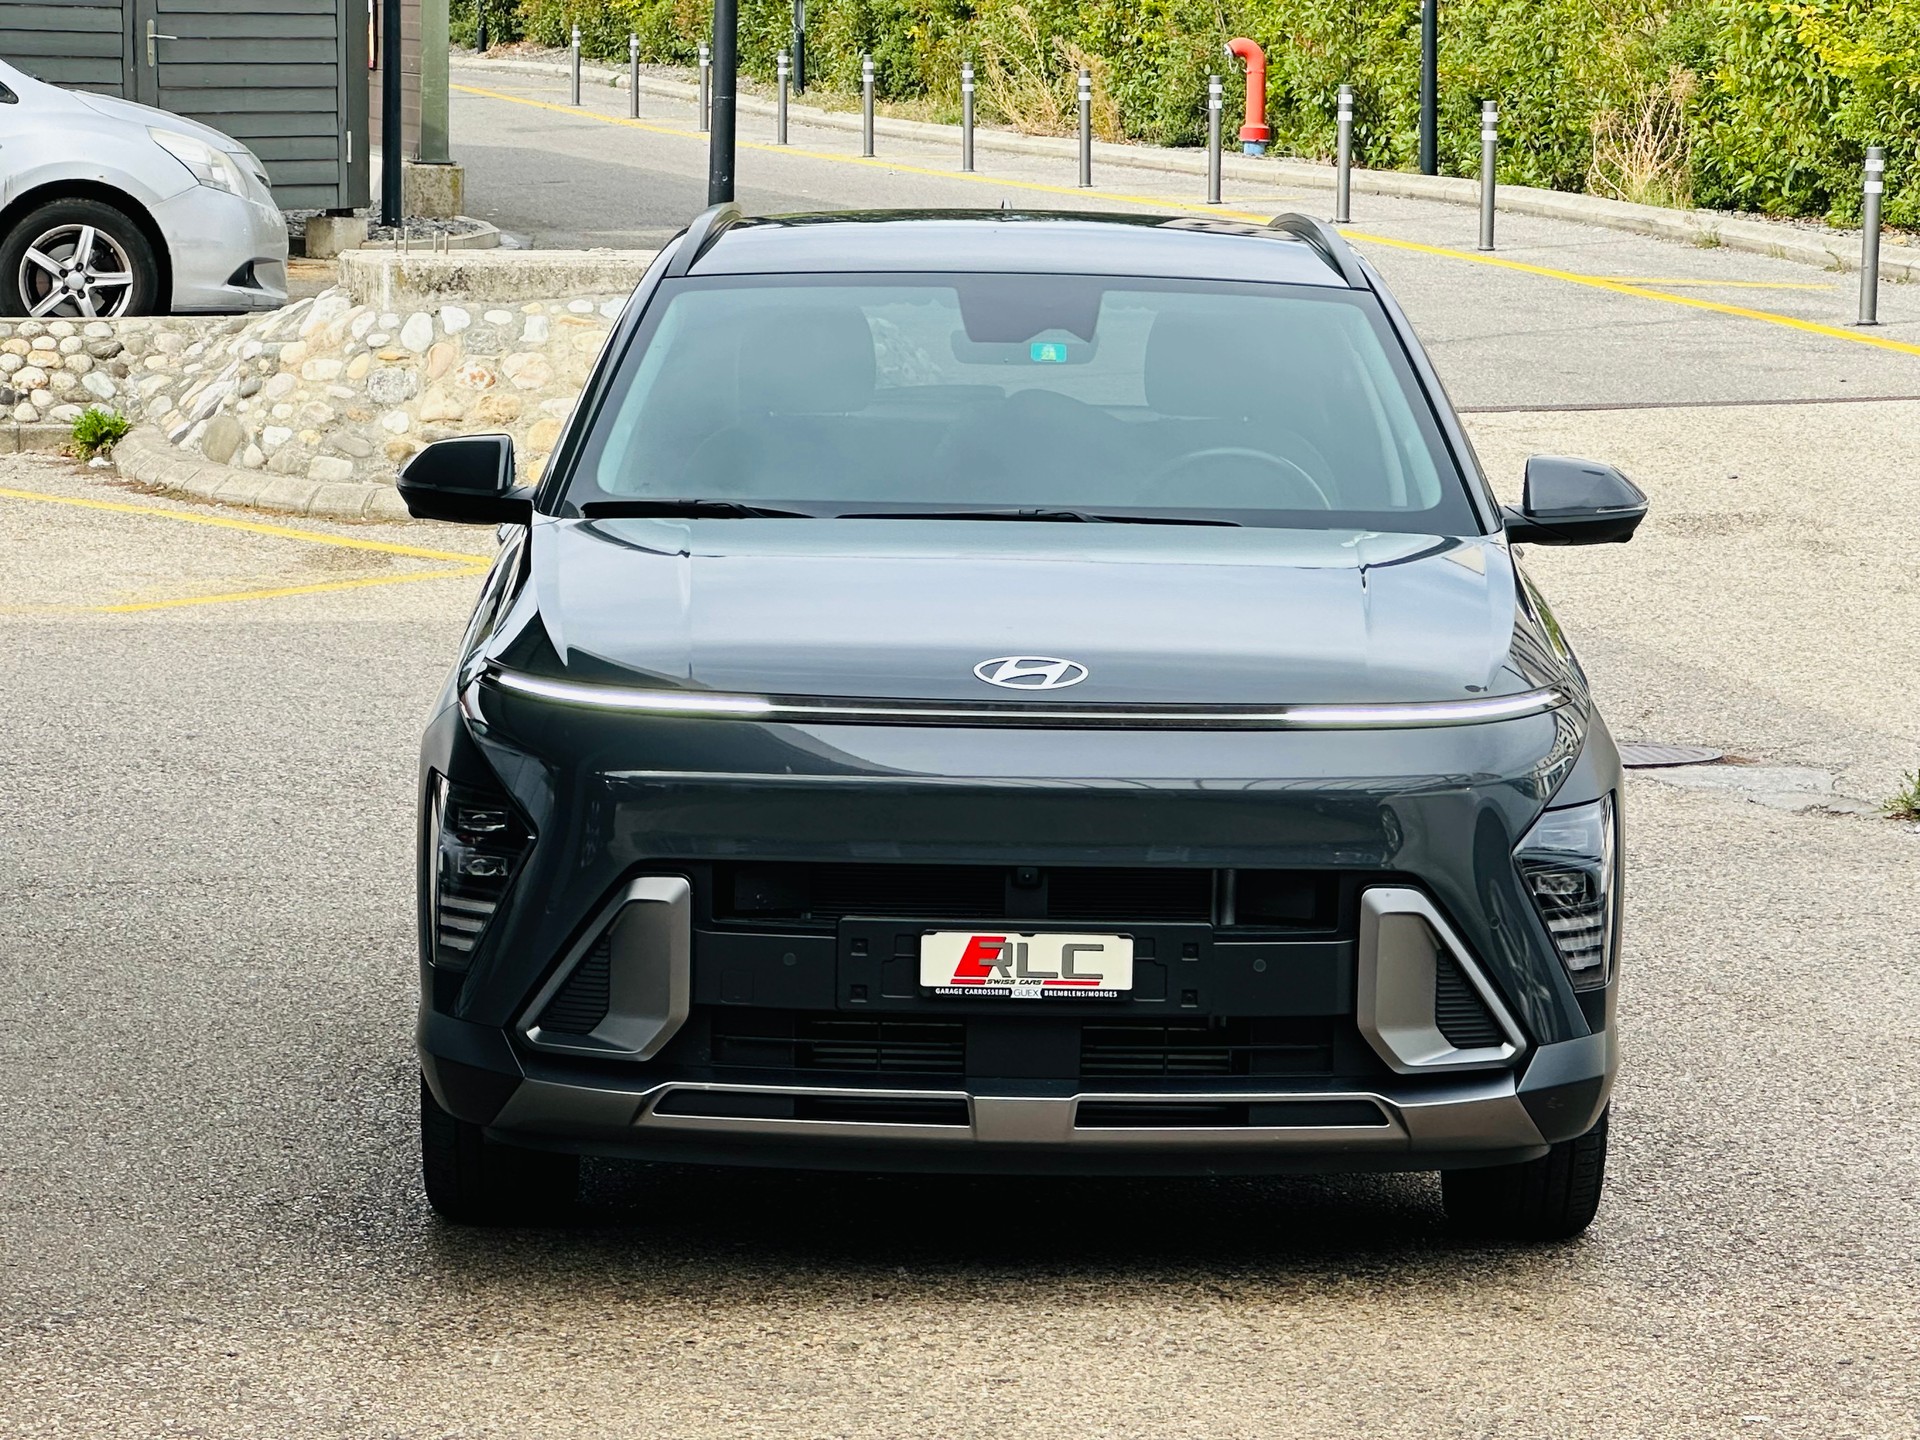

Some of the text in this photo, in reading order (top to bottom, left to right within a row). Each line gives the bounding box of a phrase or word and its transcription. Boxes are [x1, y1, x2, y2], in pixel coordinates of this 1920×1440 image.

[964, 988, 1010, 996] CARROSSERIE
[1013, 989, 1040, 998] GUEX
[1044, 990, 1118, 999] BREMBLENS/MORGES
